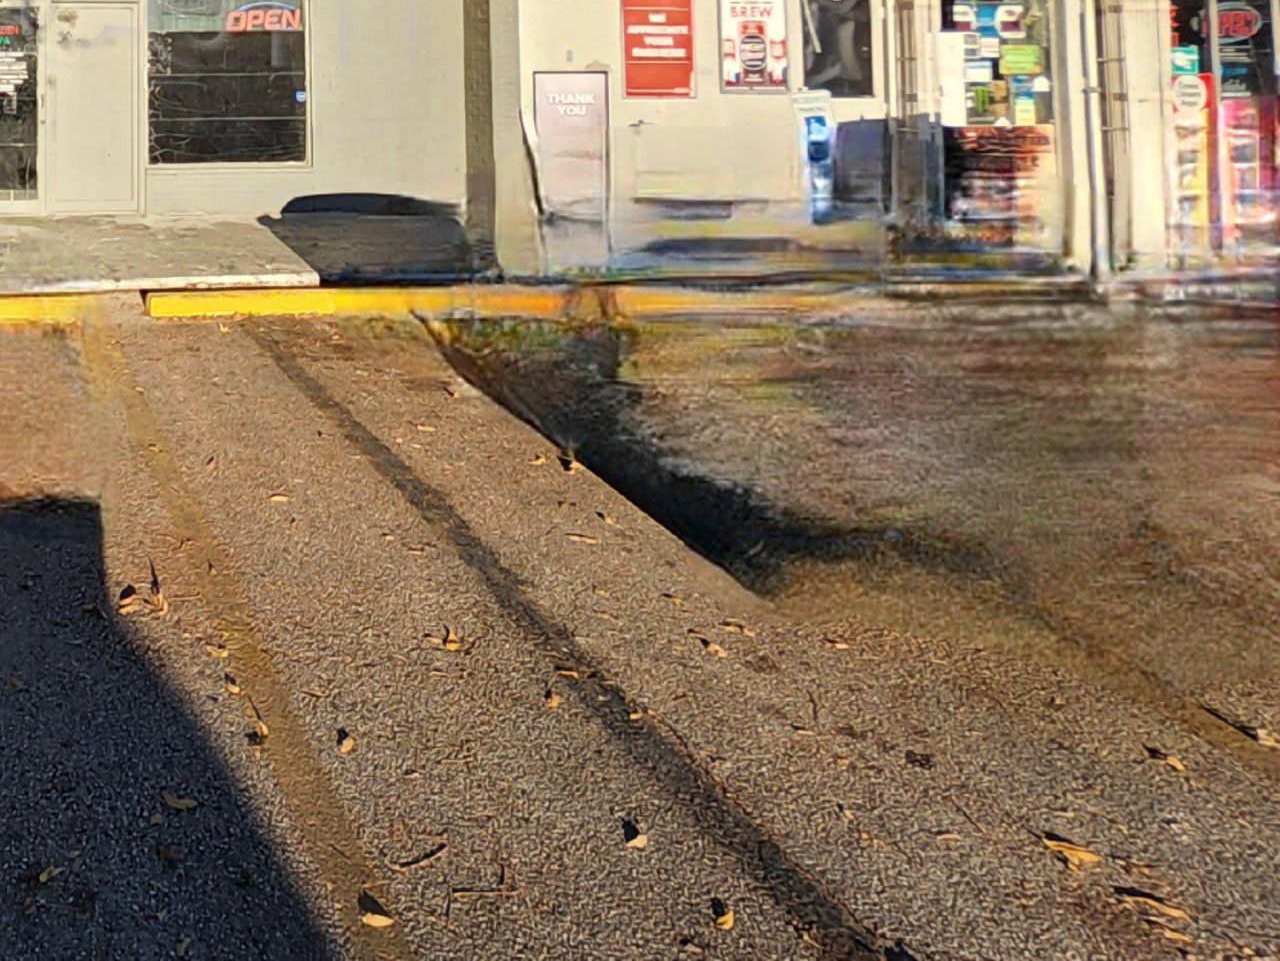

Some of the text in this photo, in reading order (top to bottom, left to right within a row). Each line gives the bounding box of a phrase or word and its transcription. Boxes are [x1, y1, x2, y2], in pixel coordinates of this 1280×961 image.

[730, 6, 774, 18] BREW
[225, 8, 302, 34] OPEN
[546, 93, 596, 105] THANK
[558, 105, 587, 117] YOU
